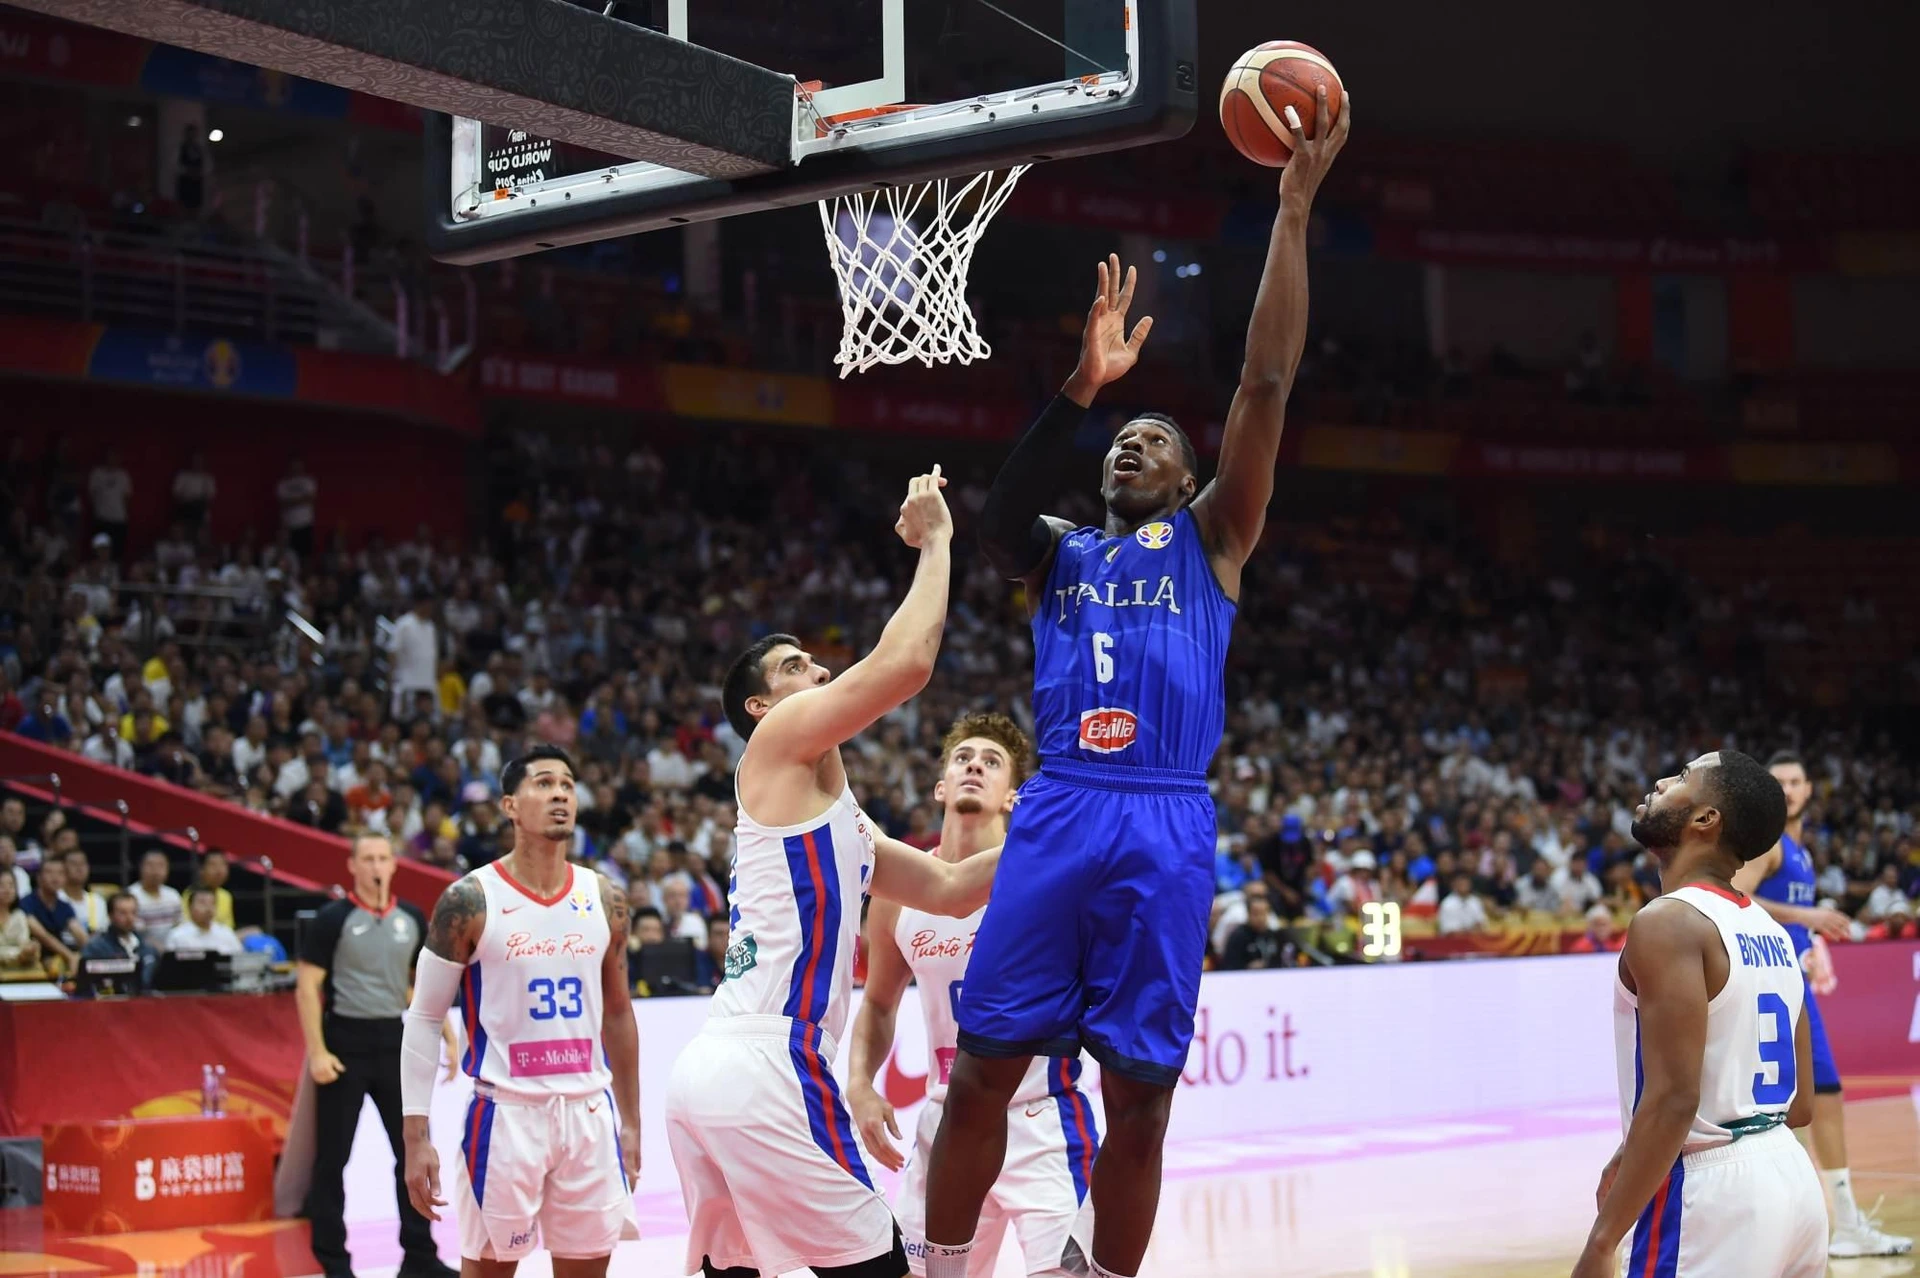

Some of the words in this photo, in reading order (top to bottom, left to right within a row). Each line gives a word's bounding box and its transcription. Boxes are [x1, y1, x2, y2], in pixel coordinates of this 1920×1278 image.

[1092, 632, 1114, 683] 6
[506, 931, 556, 961] Puerto
[911, 929, 961, 961] Puerto
[1362, 902, 1402, 957] 33
[528, 976, 583, 1020] 33
[1751, 992, 1797, 1106] 3
